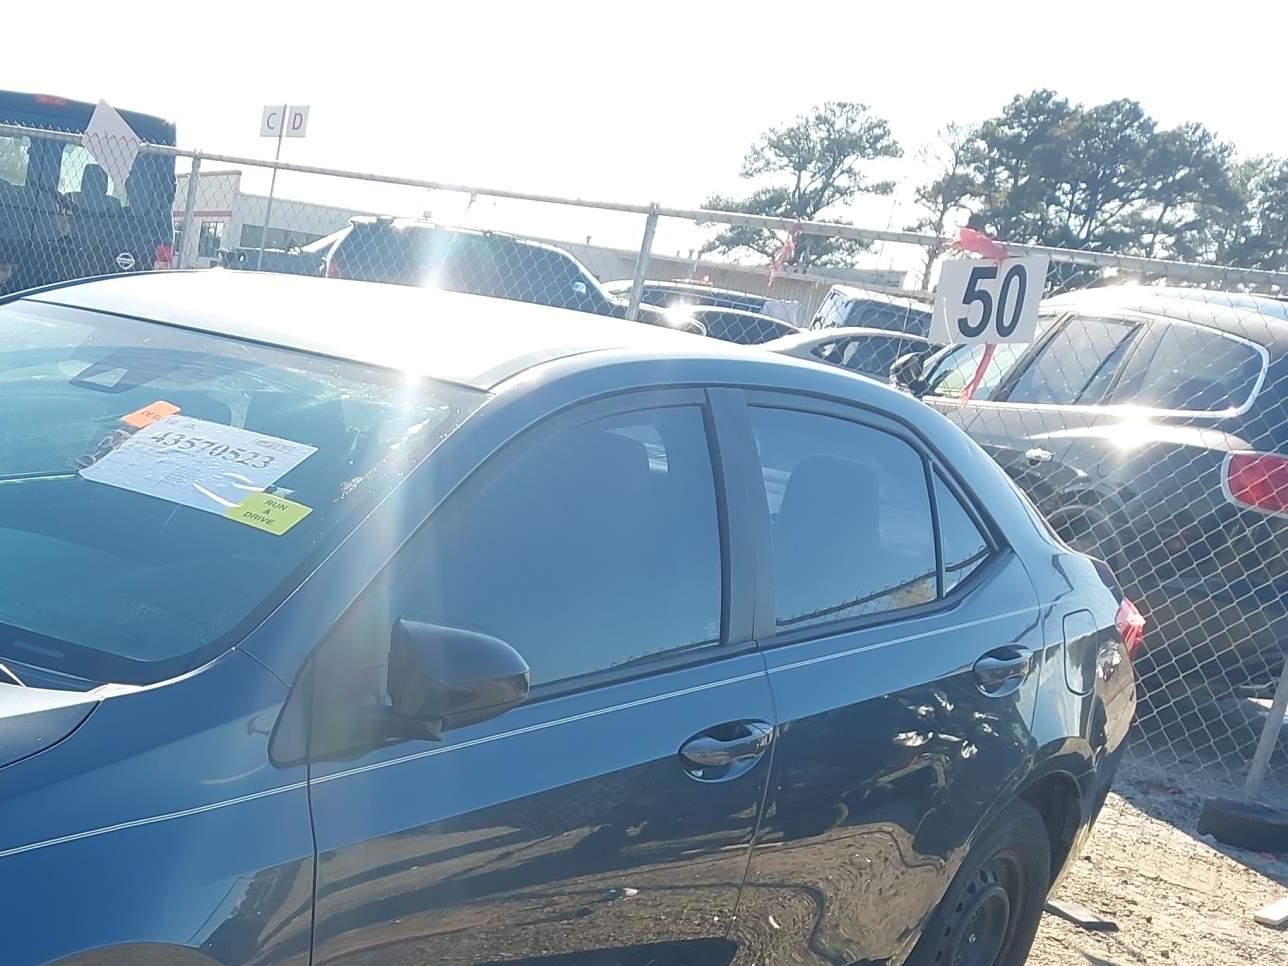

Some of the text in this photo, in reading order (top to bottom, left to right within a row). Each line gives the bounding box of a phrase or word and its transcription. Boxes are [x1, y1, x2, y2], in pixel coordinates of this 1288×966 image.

[266, 112, 278, 130] C
[292, 112, 304, 130] D
[957, 263, 1028, 338] 50
[151, 431, 276, 469] 43570523
[264, 499, 289, 511] RUN
[242, 511, 276, 526] DRIVE
